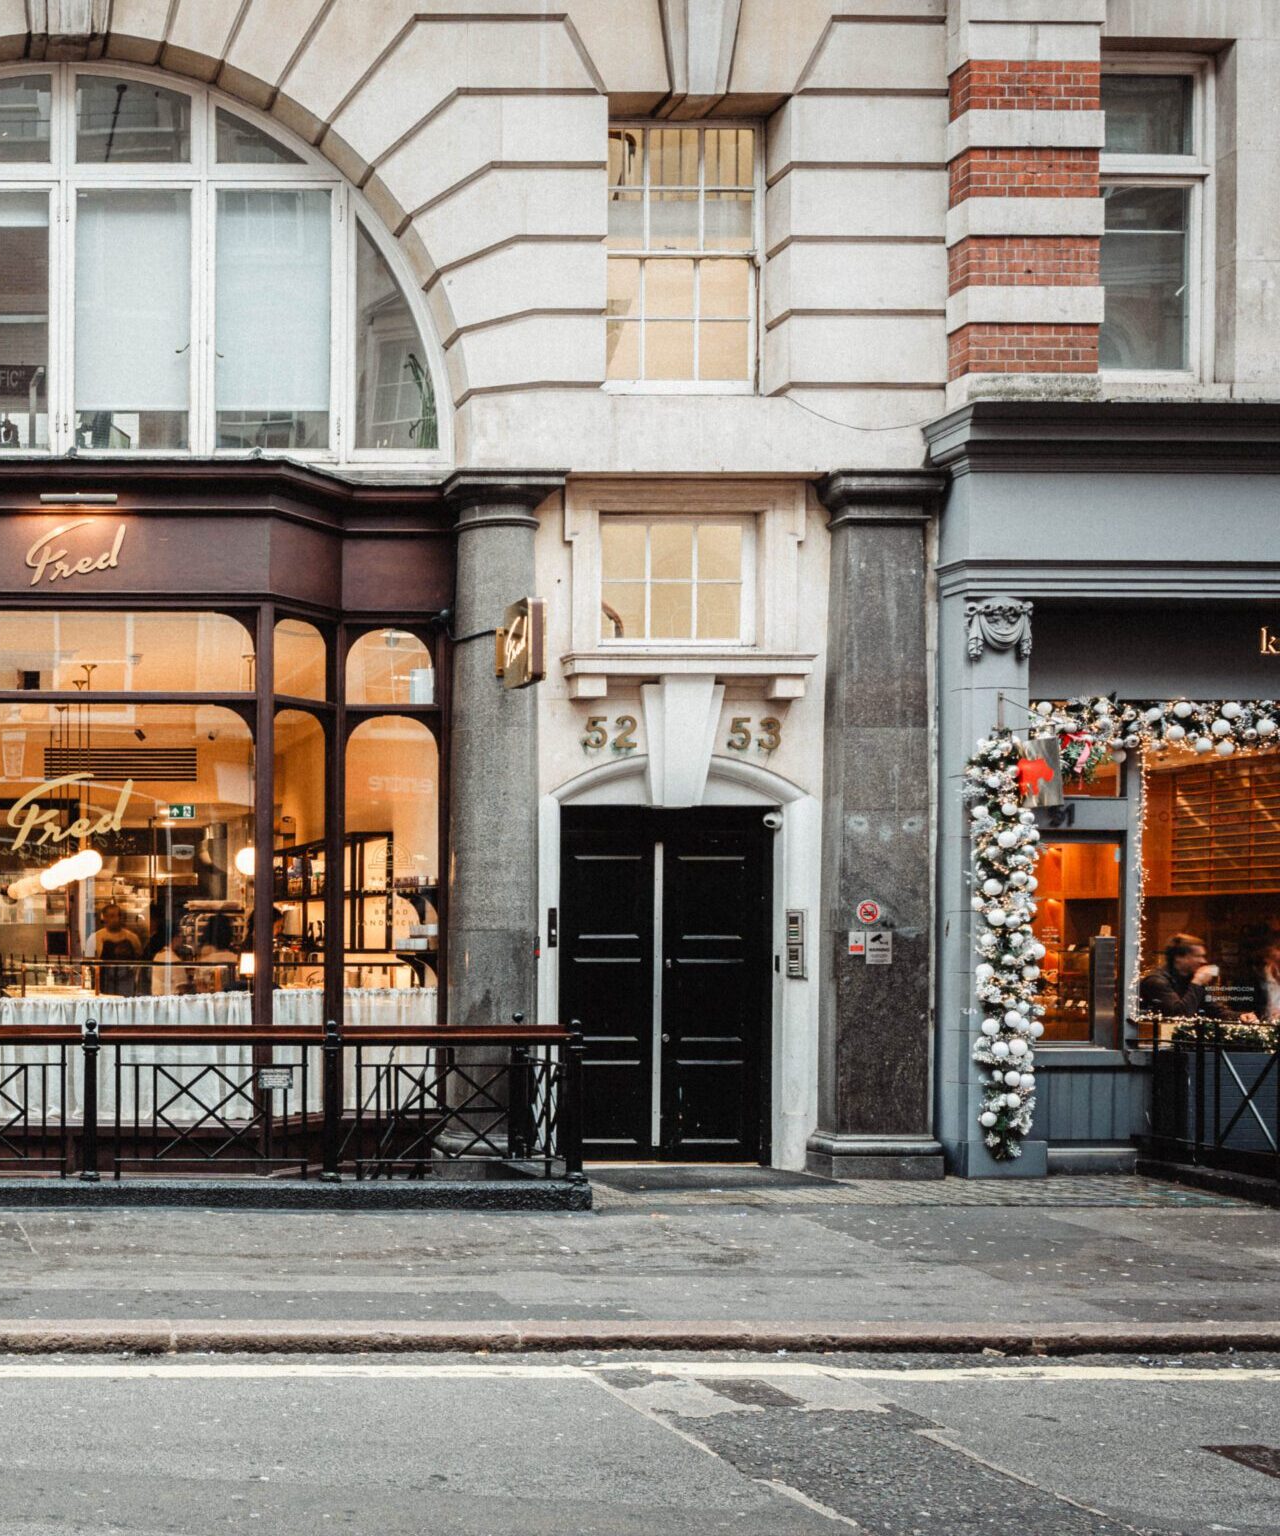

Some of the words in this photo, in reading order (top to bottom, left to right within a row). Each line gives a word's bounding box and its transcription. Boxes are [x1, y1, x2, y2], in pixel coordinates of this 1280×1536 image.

[25, 519, 126, 587] Fred
[582, 715, 638, 749] 52
[727, 716, 782, 750] 53
[7, 772, 134, 851] Fred
